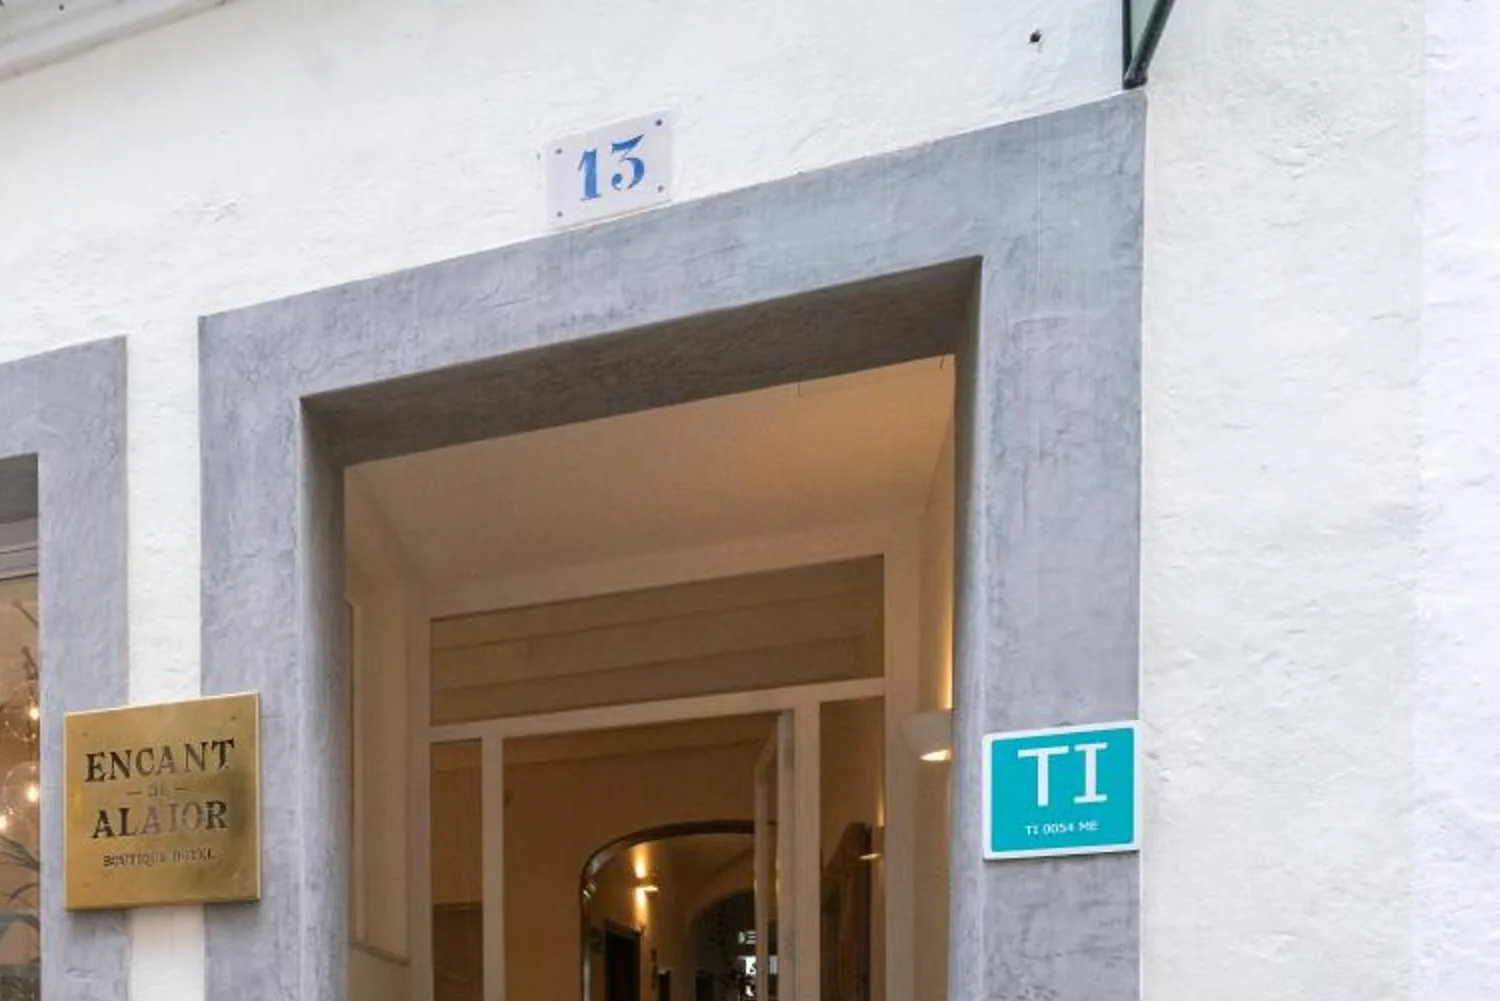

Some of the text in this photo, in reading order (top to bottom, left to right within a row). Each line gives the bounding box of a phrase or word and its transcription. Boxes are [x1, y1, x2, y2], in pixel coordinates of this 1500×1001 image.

[578, 132, 645, 202] 13
[84, 738, 235, 783] ENCANT
[1017, 741, 1108, 808] TI
[92, 799, 228, 839] ALAIOR
